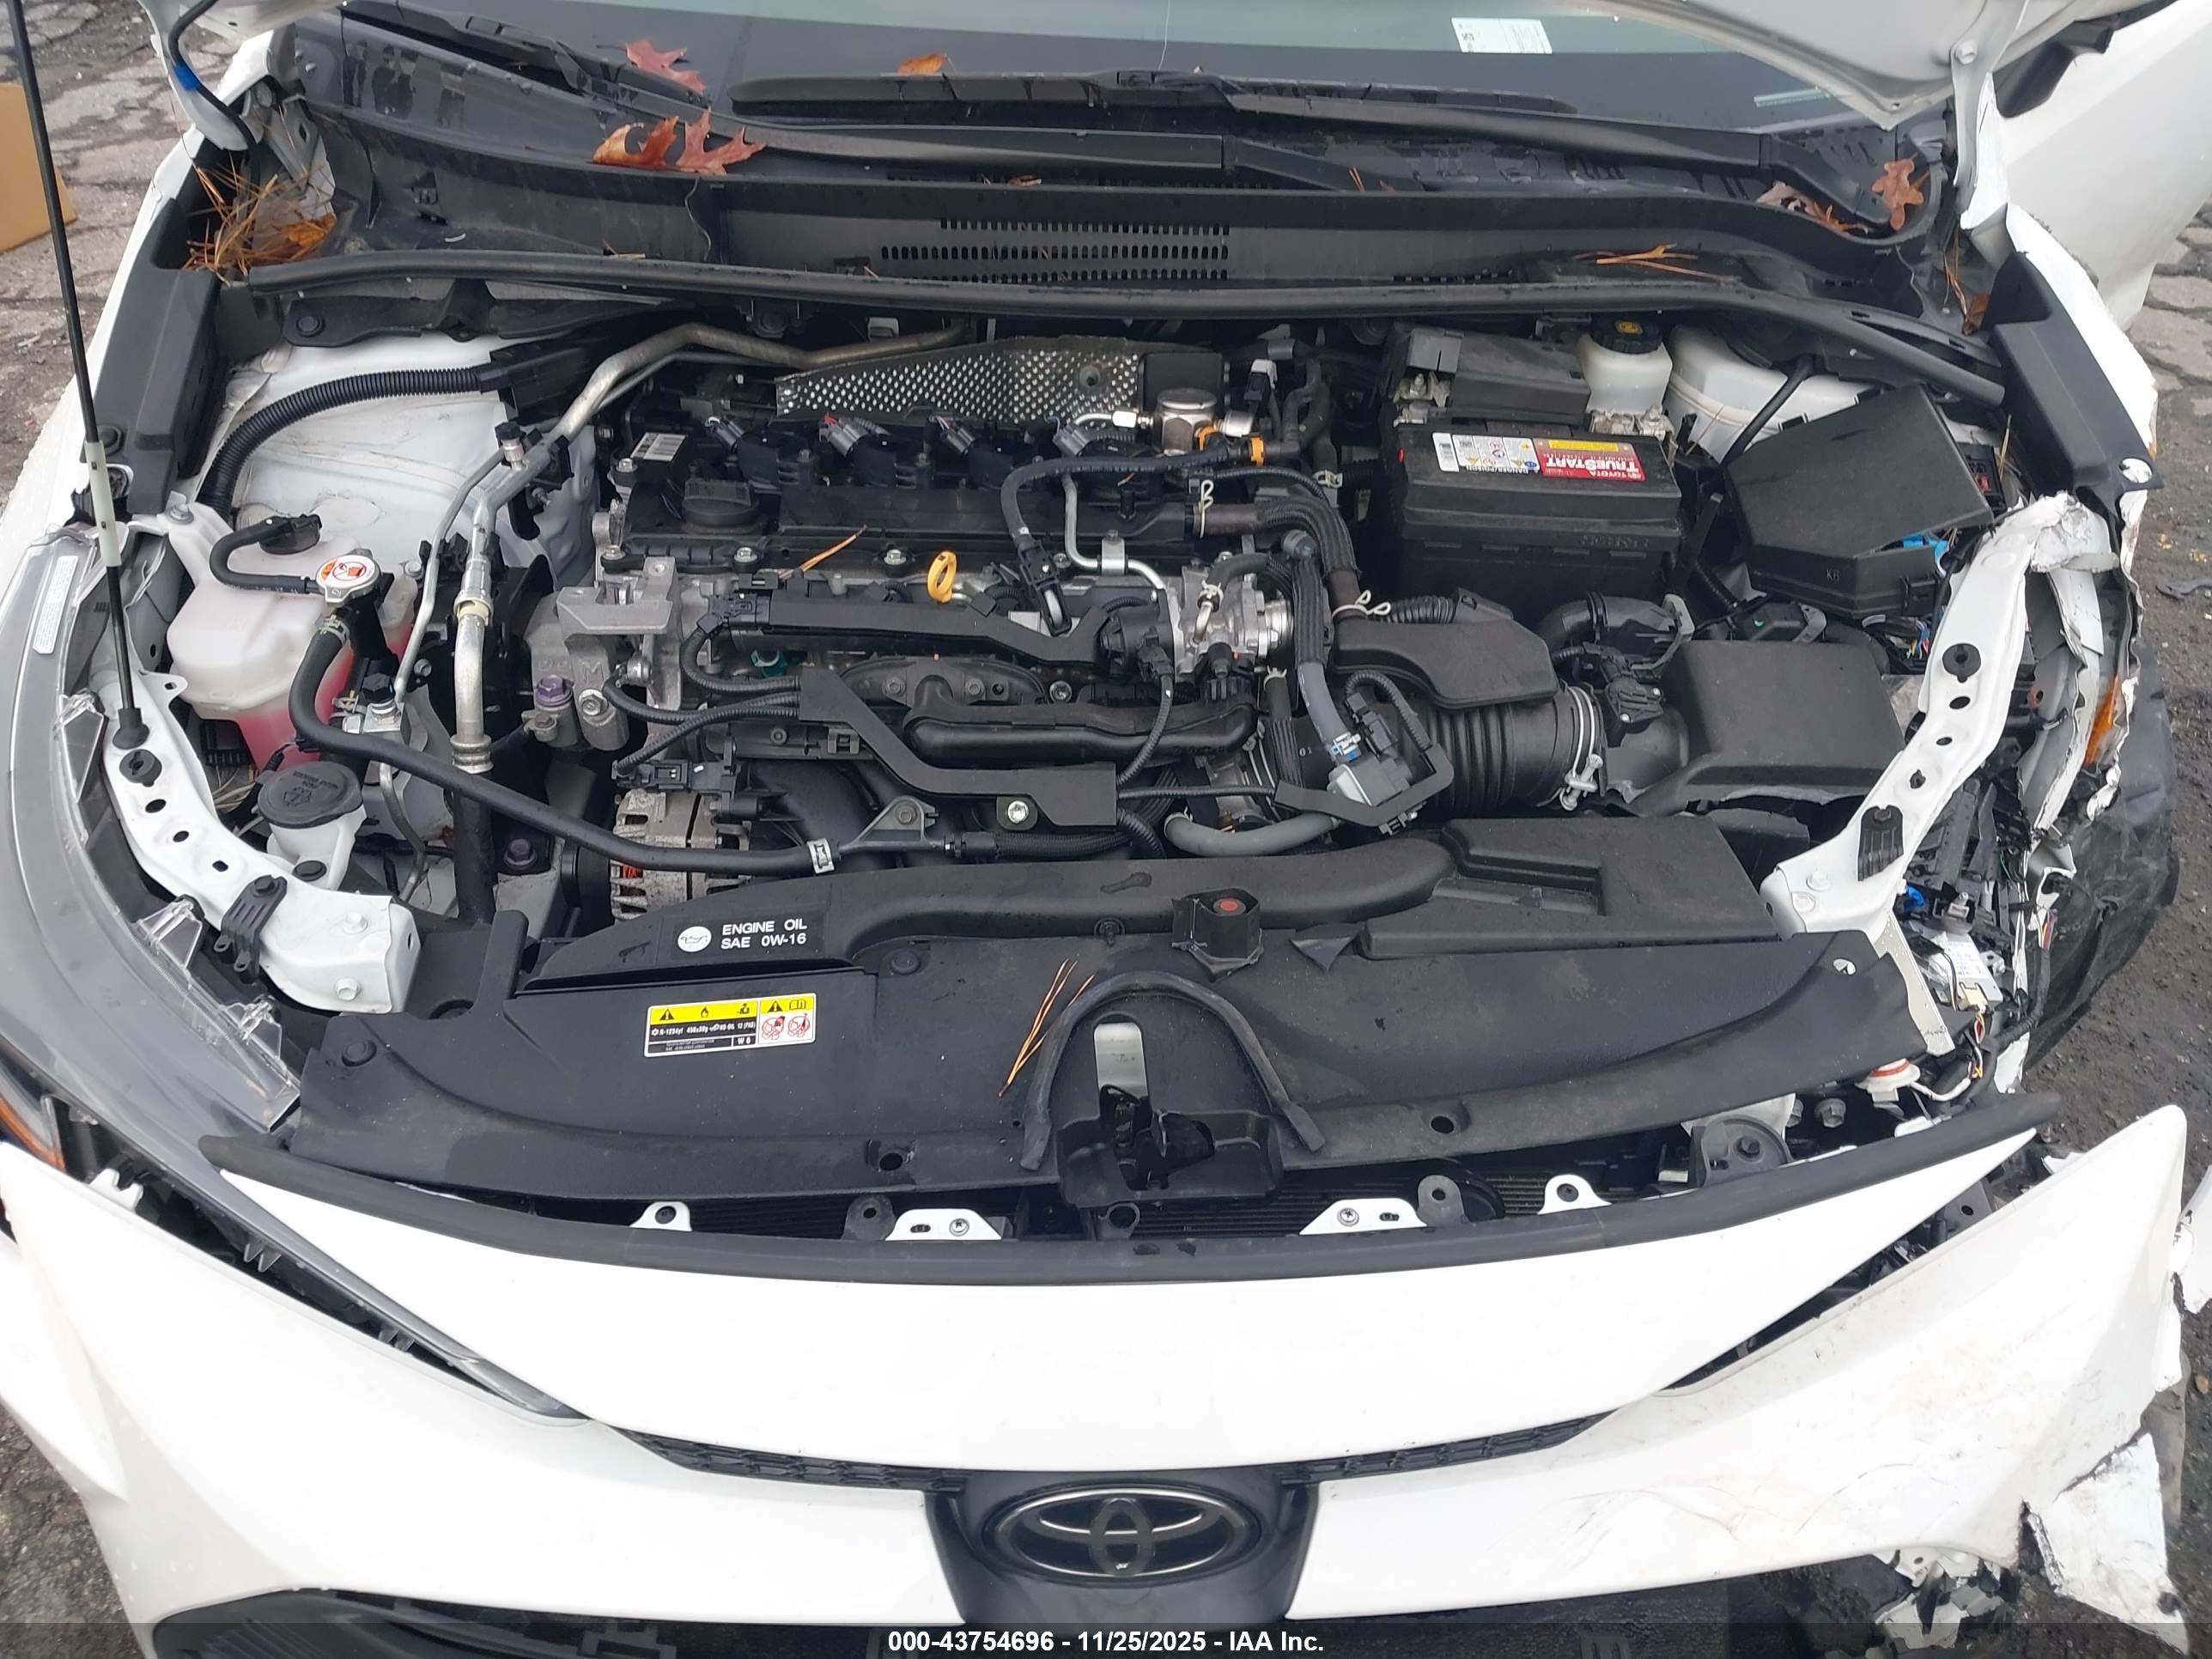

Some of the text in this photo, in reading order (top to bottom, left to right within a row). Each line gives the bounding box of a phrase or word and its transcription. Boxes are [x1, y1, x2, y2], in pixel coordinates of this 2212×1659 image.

[1589, 470, 1626, 478] TOYOTA
[722, 918, 808, 936] ENGINE OIL
[721, 933, 807, 950] SAE 0W-16
